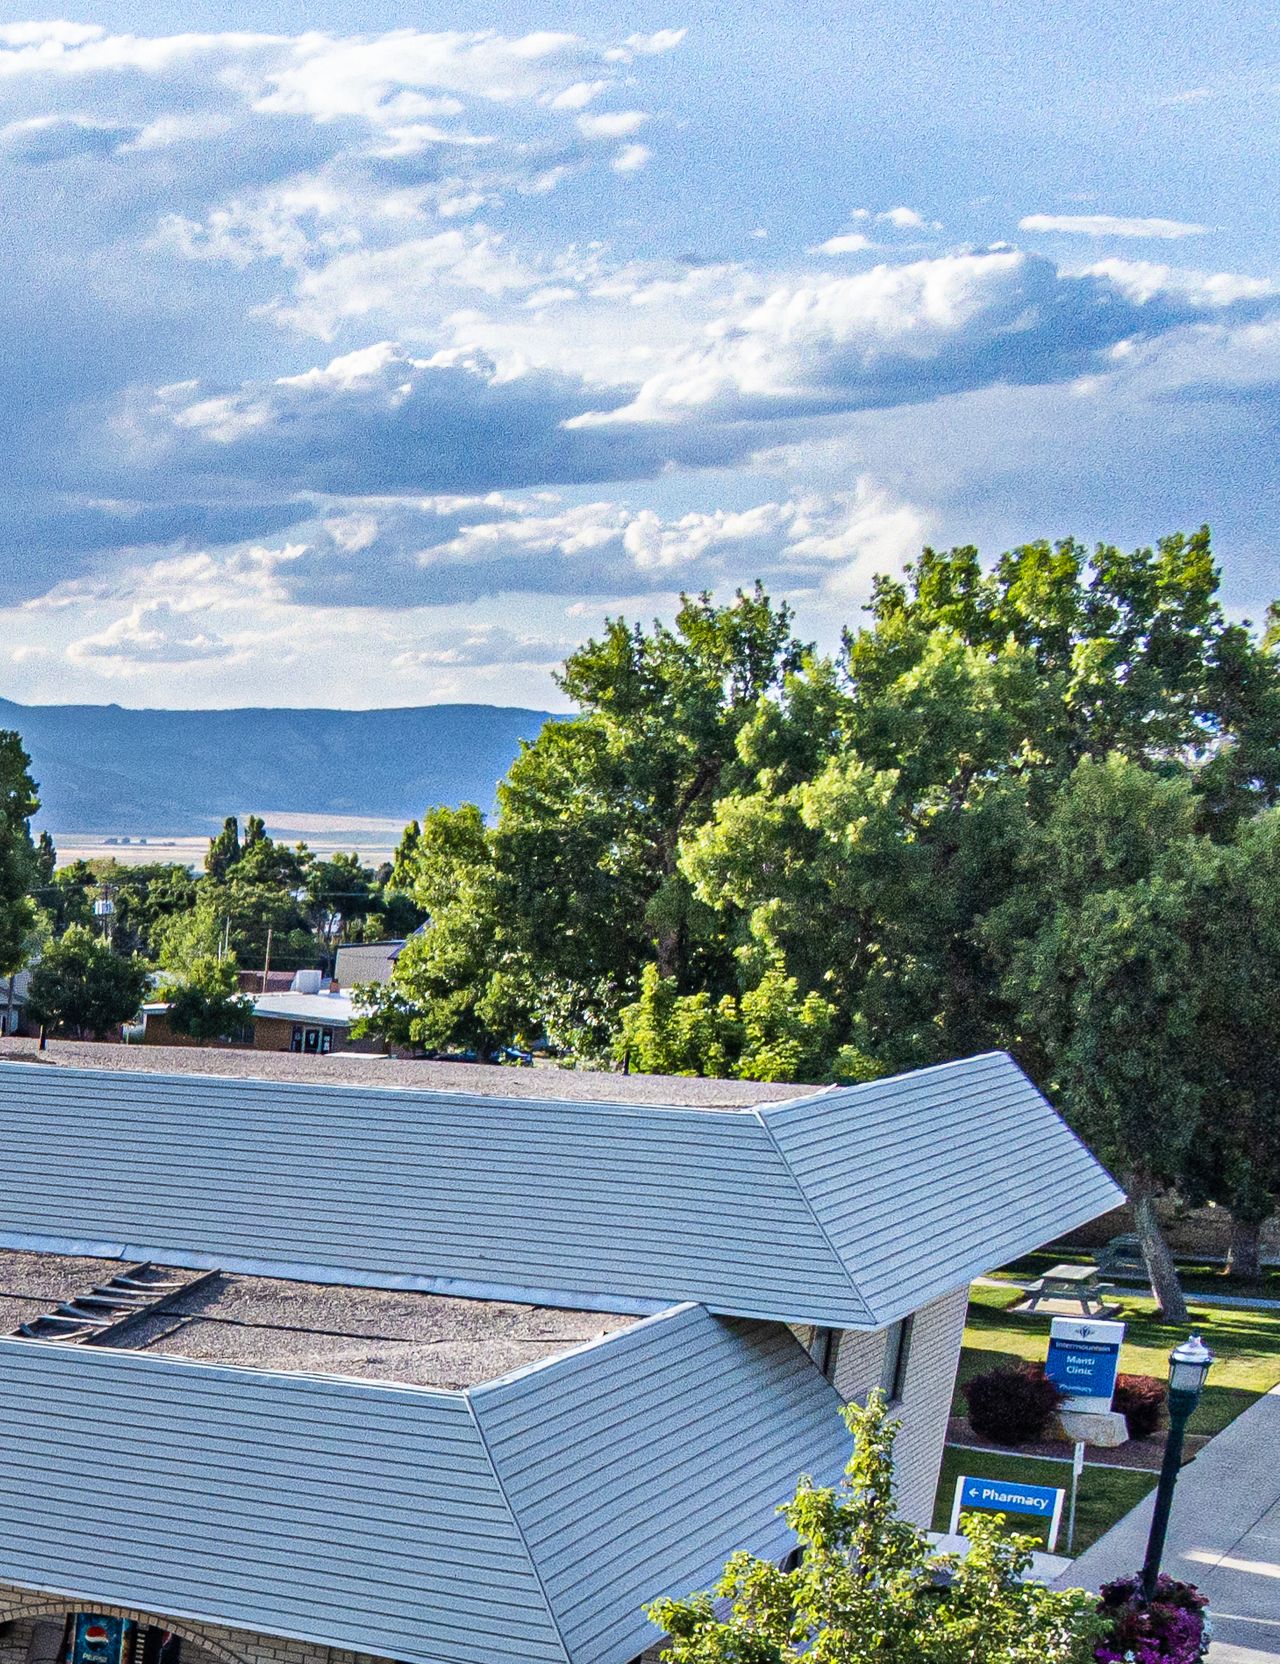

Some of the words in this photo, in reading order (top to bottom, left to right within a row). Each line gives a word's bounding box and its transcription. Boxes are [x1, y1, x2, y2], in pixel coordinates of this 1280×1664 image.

[1066, 1355, 1095, 1366] Manti
[1066, 1365, 1094, 1376] Clinic
[982, 1488, 1049, 1510] Pharmacy
